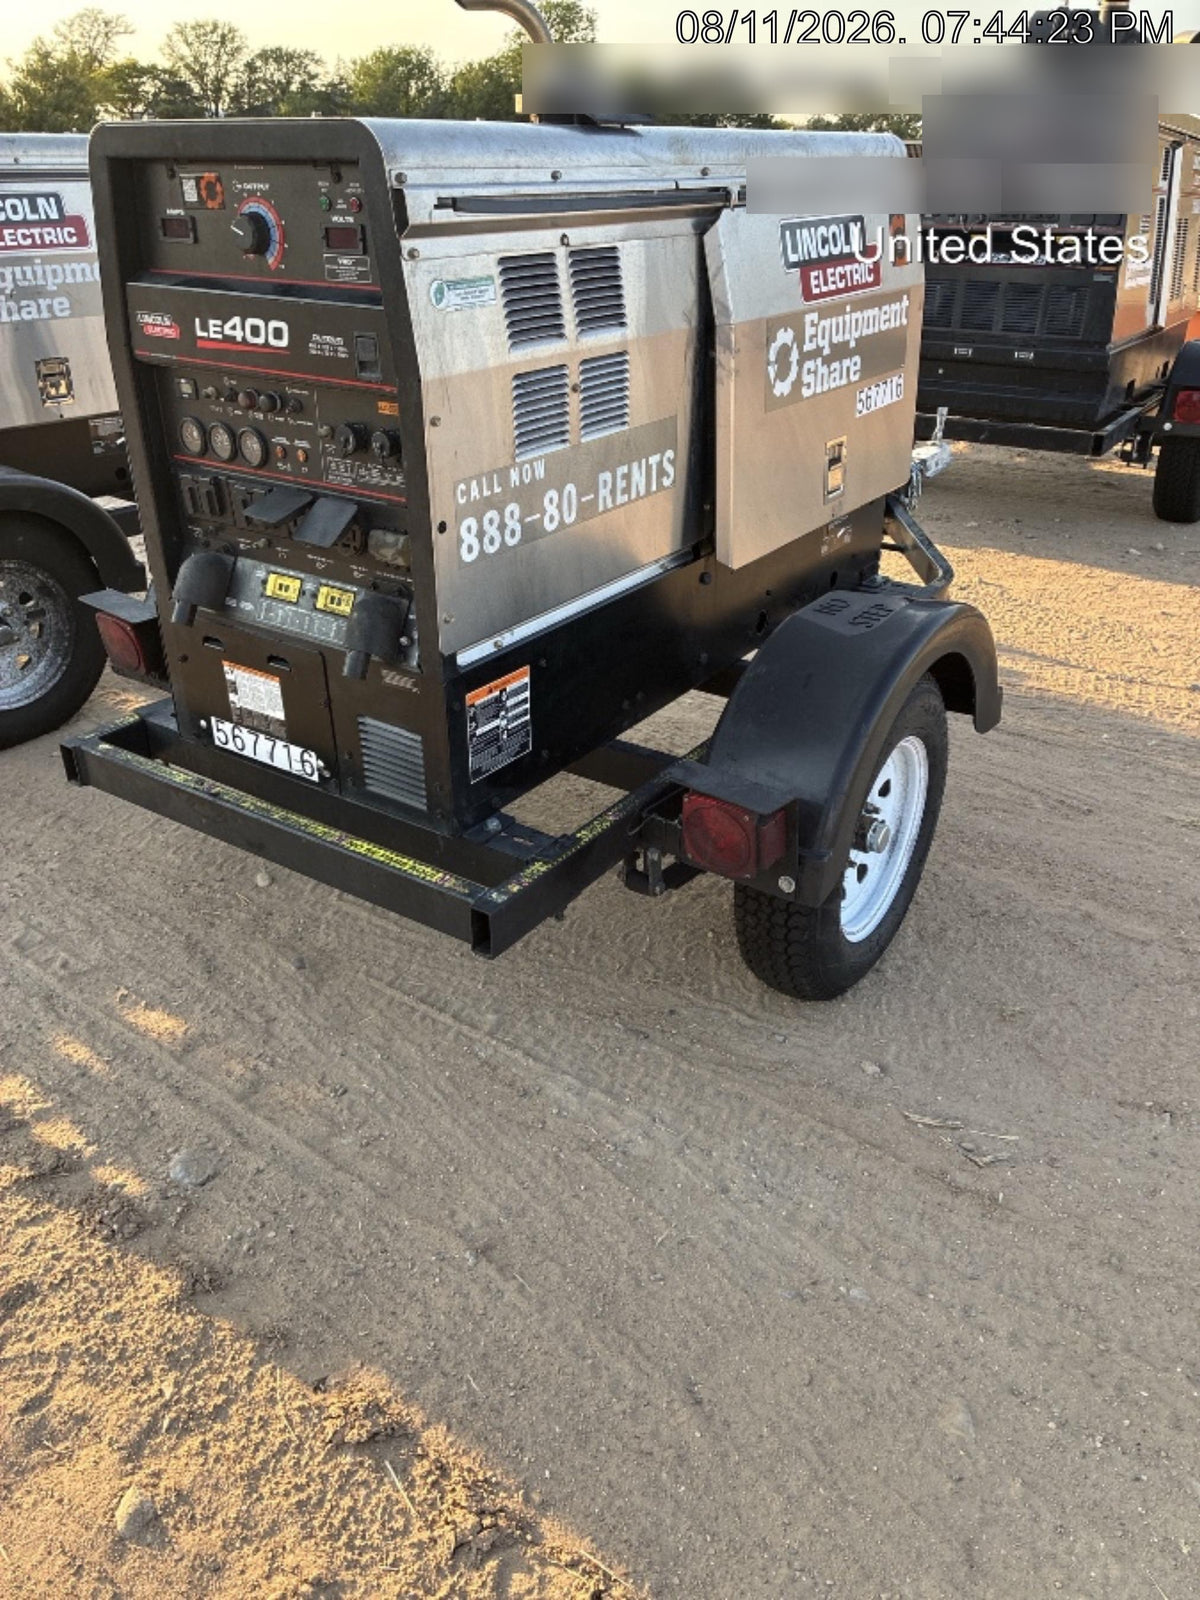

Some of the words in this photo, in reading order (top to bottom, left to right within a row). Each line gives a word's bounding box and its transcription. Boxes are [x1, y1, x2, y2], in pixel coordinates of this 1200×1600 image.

[809, 262, 875, 295] ELECTRIC
[194, 315, 290, 348] LE400
[803, 294, 910, 356] Equipment
[801, 354, 862, 399] Share
[456, 473, 503, 504] CALL
[510, 458, 547, 489] NOW
[458, 449, 676, 564] 888-80-RENTS
[215, 719, 316, 778] 567716
